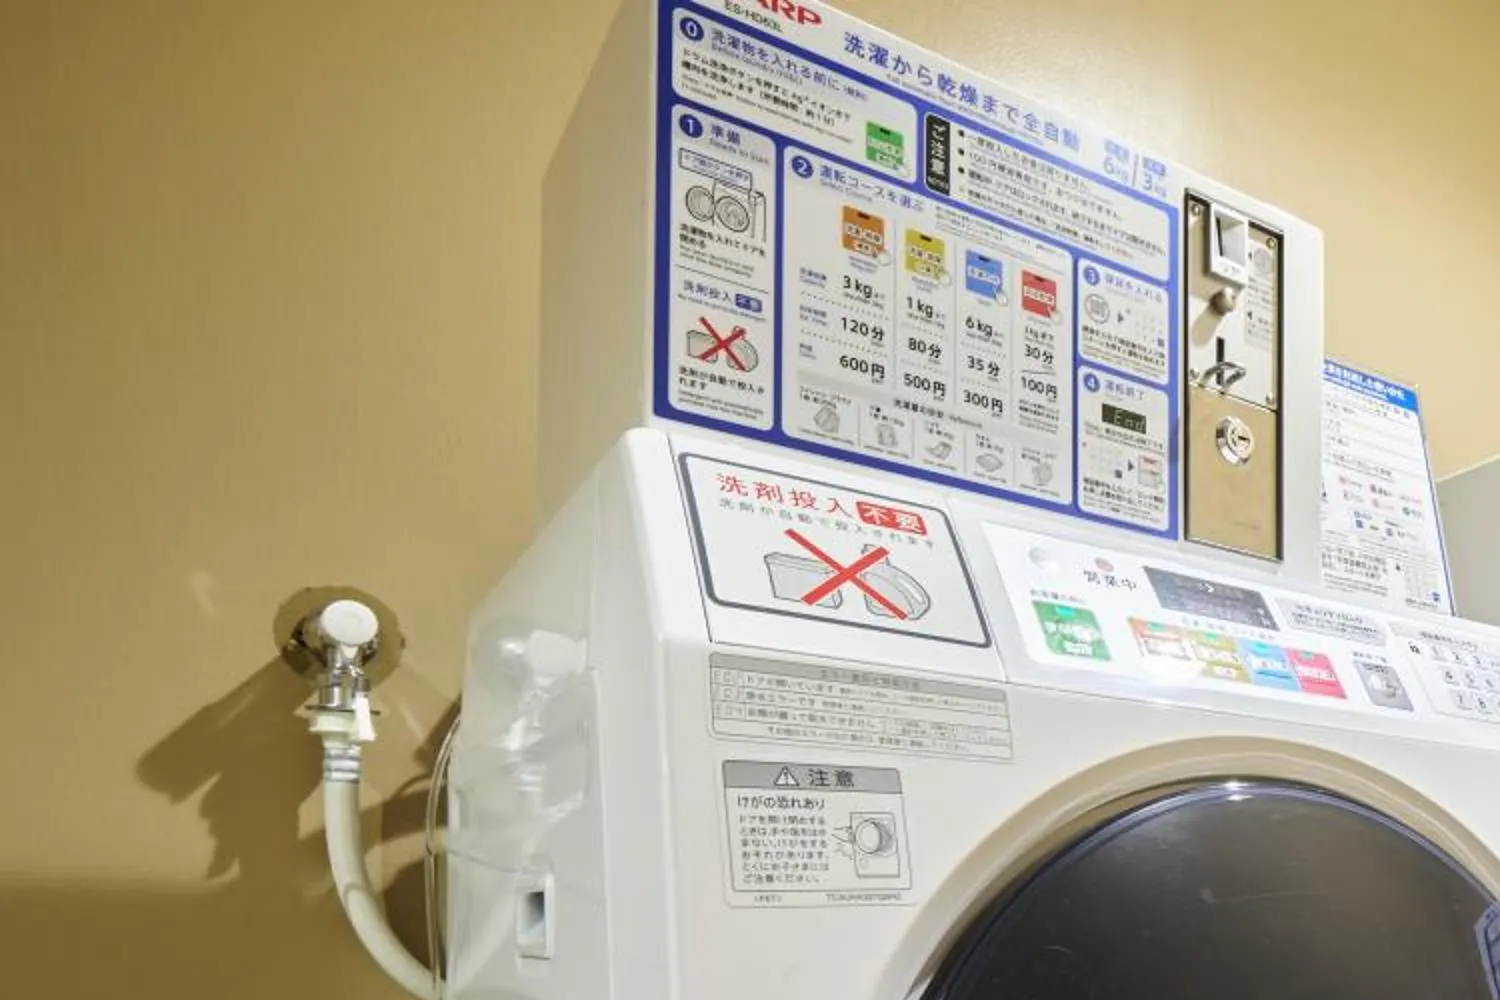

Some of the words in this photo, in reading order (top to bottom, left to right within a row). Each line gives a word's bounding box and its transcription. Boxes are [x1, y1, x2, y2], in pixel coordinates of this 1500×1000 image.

[843, 31, 1079, 151] 洗濯から乾燥まで全自動
[854, 276, 873, 300] kg
[916, 298, 934, 319] kg
[841, 317, 885, 342] 120分
[976, 318, 993, 340] kg
[908, 337, 942, 359] 80分
[1025, 344, 1054, 366] 30分
[840, 355, 886, 379] 600円
[967, 356, 1001, 378] 35分
[903, 373, 946, 397] 500円
[1021, 376, 1057, 400] 100円
[963, 389, 1003, 413] 300円
[716, 472, 852, 517] 洗剤投入
[862, 503, 922, 534] 不要
[808, 768, 855, 788] 注意
[737, 795, 825, 810] けがの恐れあり
